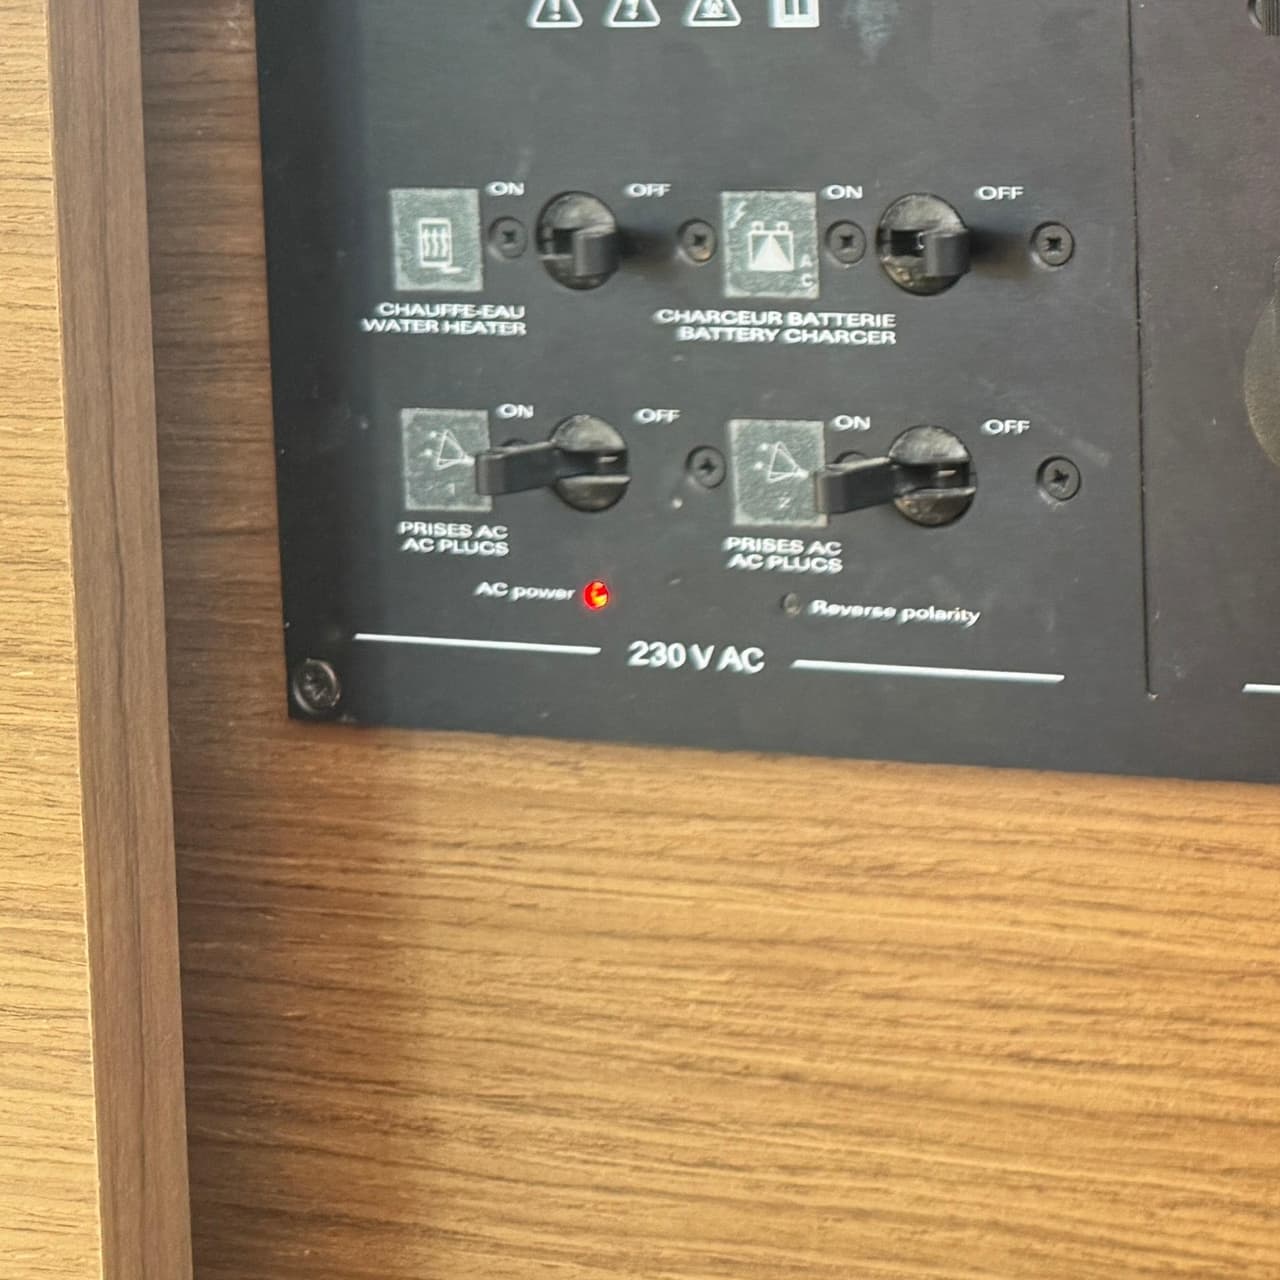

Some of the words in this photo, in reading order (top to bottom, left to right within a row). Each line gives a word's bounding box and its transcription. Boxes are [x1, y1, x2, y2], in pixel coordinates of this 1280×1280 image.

[487, 181, 525, 196] ON
[625, 183, 671, 198] OFF
[822, 184, 863, 200] ON
[975, 185, 1024, 201] OFF
[373, 302, 527, 319] CHAUFFE-EAU
[361, 318, 440, 334] WATER
[441, 320, 528, 336] HEATER
[788, 311, 898, 328] BATTERIE
[674, 325, 782, 342] BATTERY
[497, 403, 534, 419] ON
[634, 408, 680, 424] OFF
[831, 414, 871, 431] ON
[982, 419, 1030, 435] OFF
[398, 521, 474, 539] PRISES
[474, 524, 508, 540] AC
[400, 538, 438, 554] AC
[723, 536, 804, 556] PRISES
[804, 540, 843, 557] AC
[727, 553, 766, 571] AC
[475, 581, 509, 597] AC
[510, 586, 576, 601] power
[810, 599, 897, 619] Reverse
[900, 605, 981, 627] polarity
[625, 638, 688, 669] 230
[687, 642, 716, 672] V
[716, 644, 766, 674] AC
